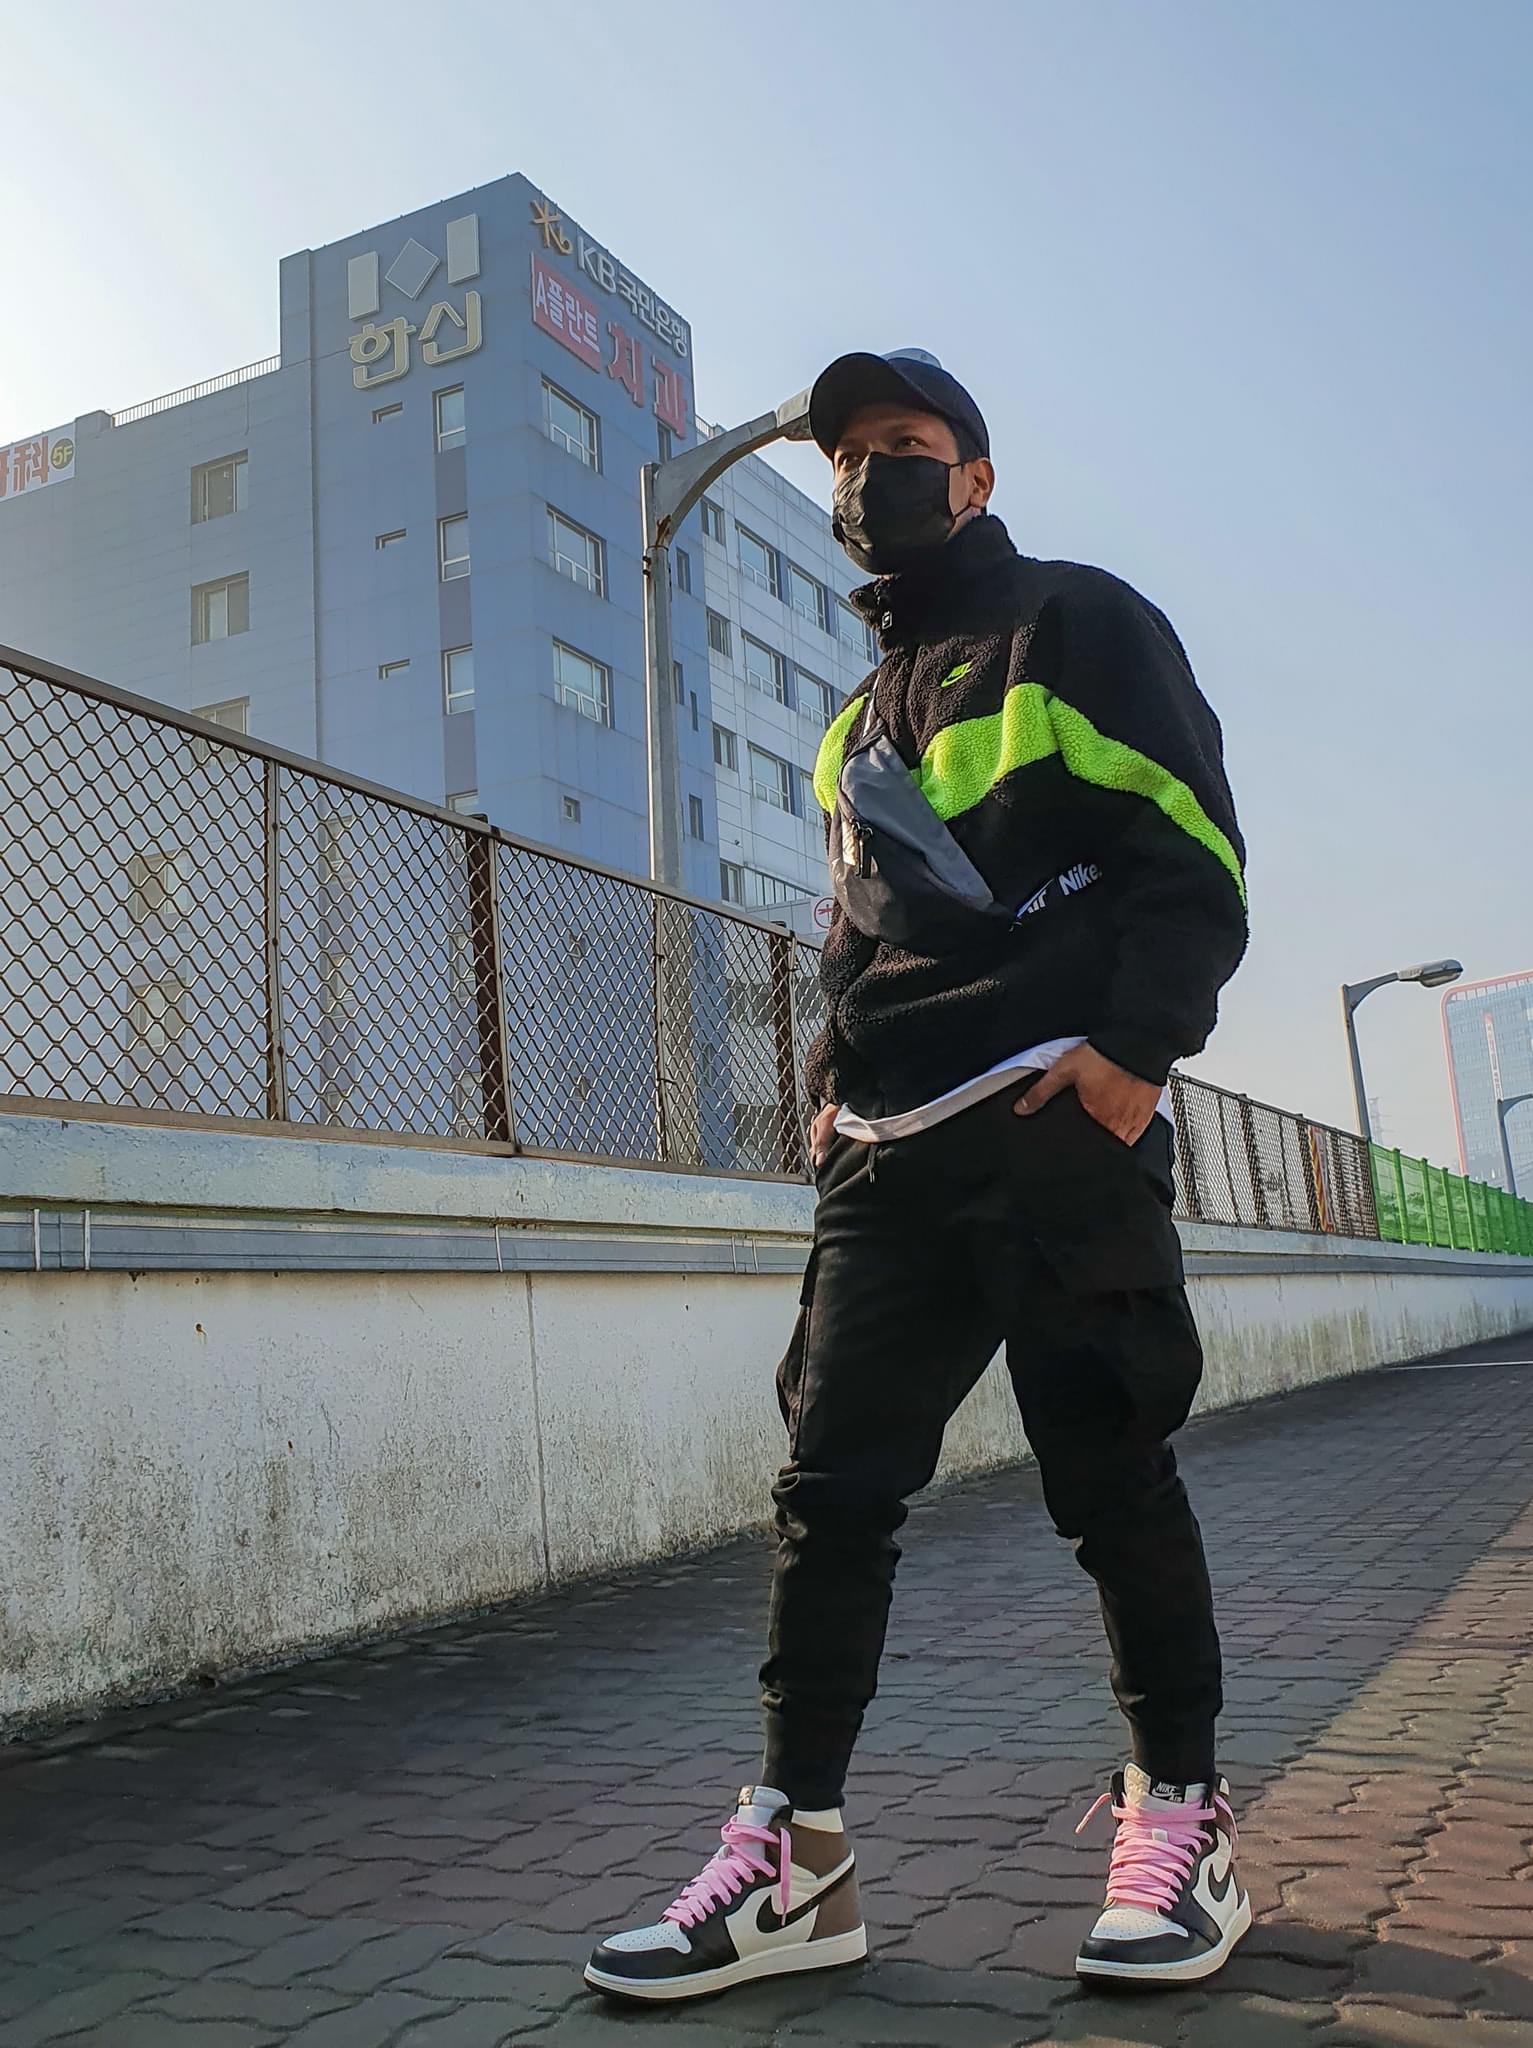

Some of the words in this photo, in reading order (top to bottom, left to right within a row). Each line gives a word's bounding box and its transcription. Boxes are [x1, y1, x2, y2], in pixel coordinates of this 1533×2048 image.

[348, 291, 482, 389] 한신
[535, 271, 600, 352] A플란트
[607, 321, 688, 440] 치과
[51, 444, 73, 467] 5F
[1156, 1781, 1177, 1793] NIKE
